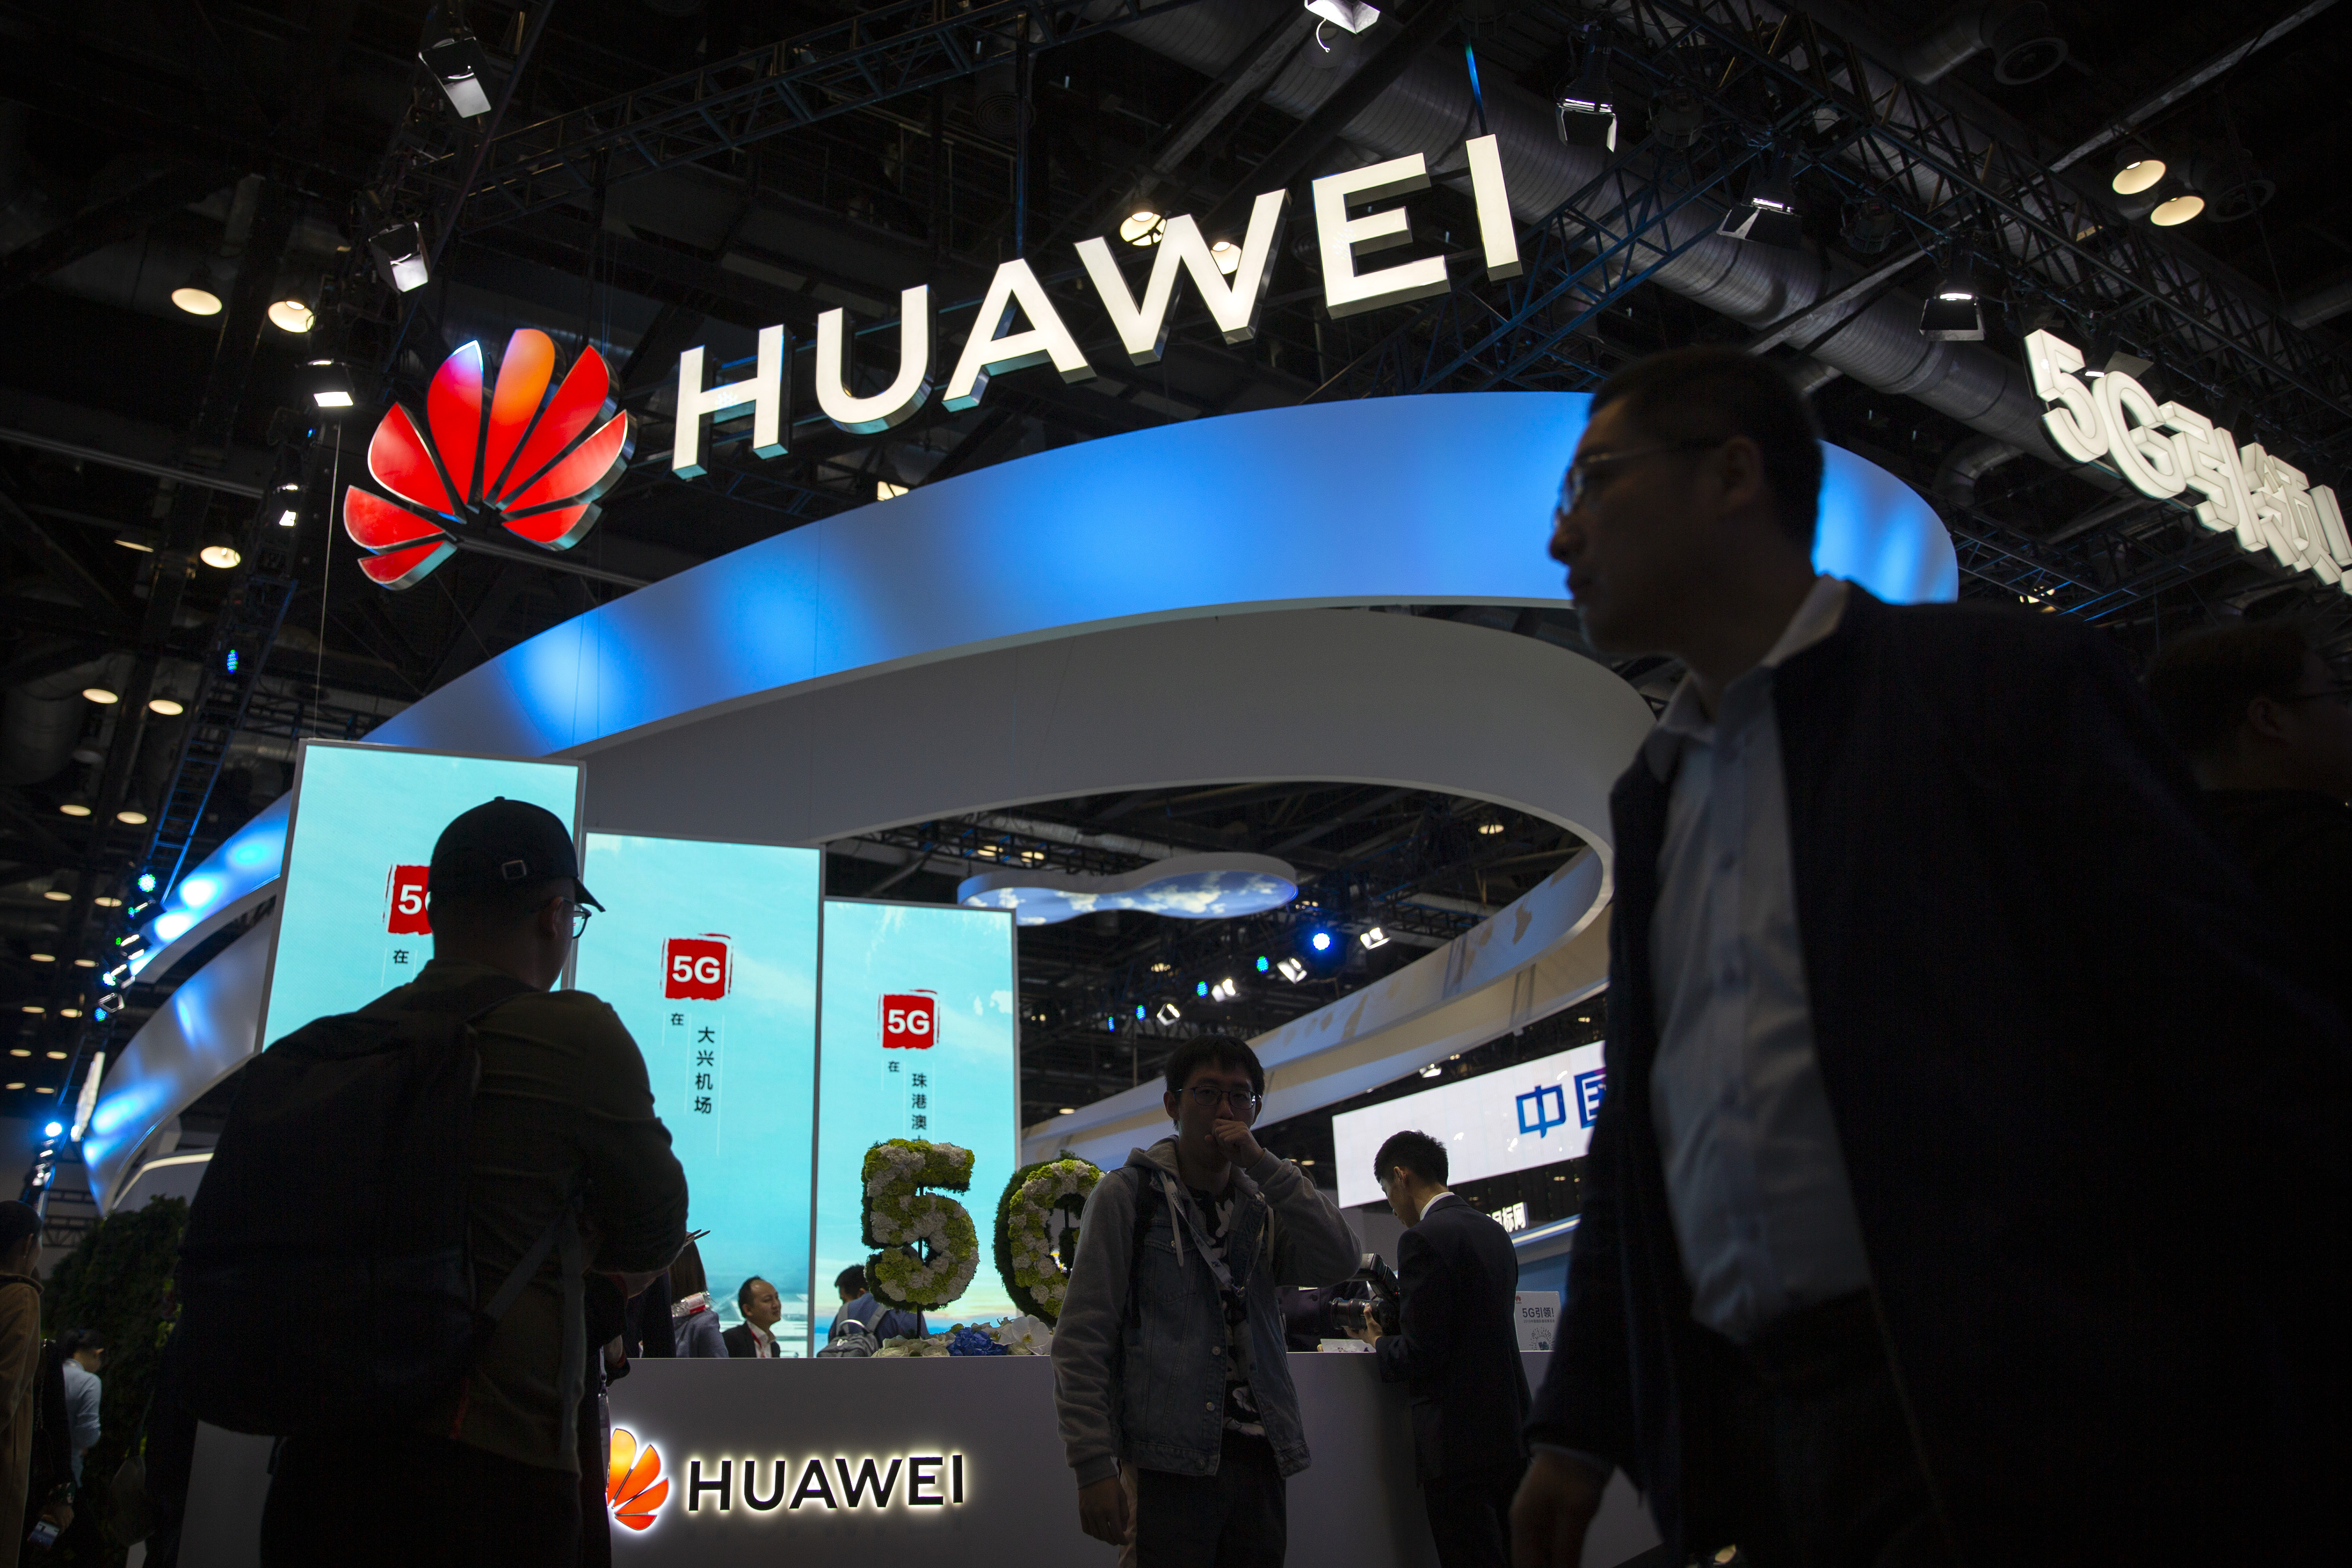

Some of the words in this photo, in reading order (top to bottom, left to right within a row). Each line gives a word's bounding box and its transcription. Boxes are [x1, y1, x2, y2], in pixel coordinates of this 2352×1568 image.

[672, 134, 1522, 479] HUAWEI
[398, 884, 431, 915] 5
[393, 949, 409, 964] 在
[672, 955, 720, 984] 5G
[671, 1013, 684, 1026] 在
[887, 1009, 930, 1035] 5G
[694, 1026, 715, 1114] 大兴机场
[889, 1061, 899, 1073] 在
[1522, 1307, 1554, 1318] 5G引领!
[689, 1455, 963, 1511] HUAWEI
